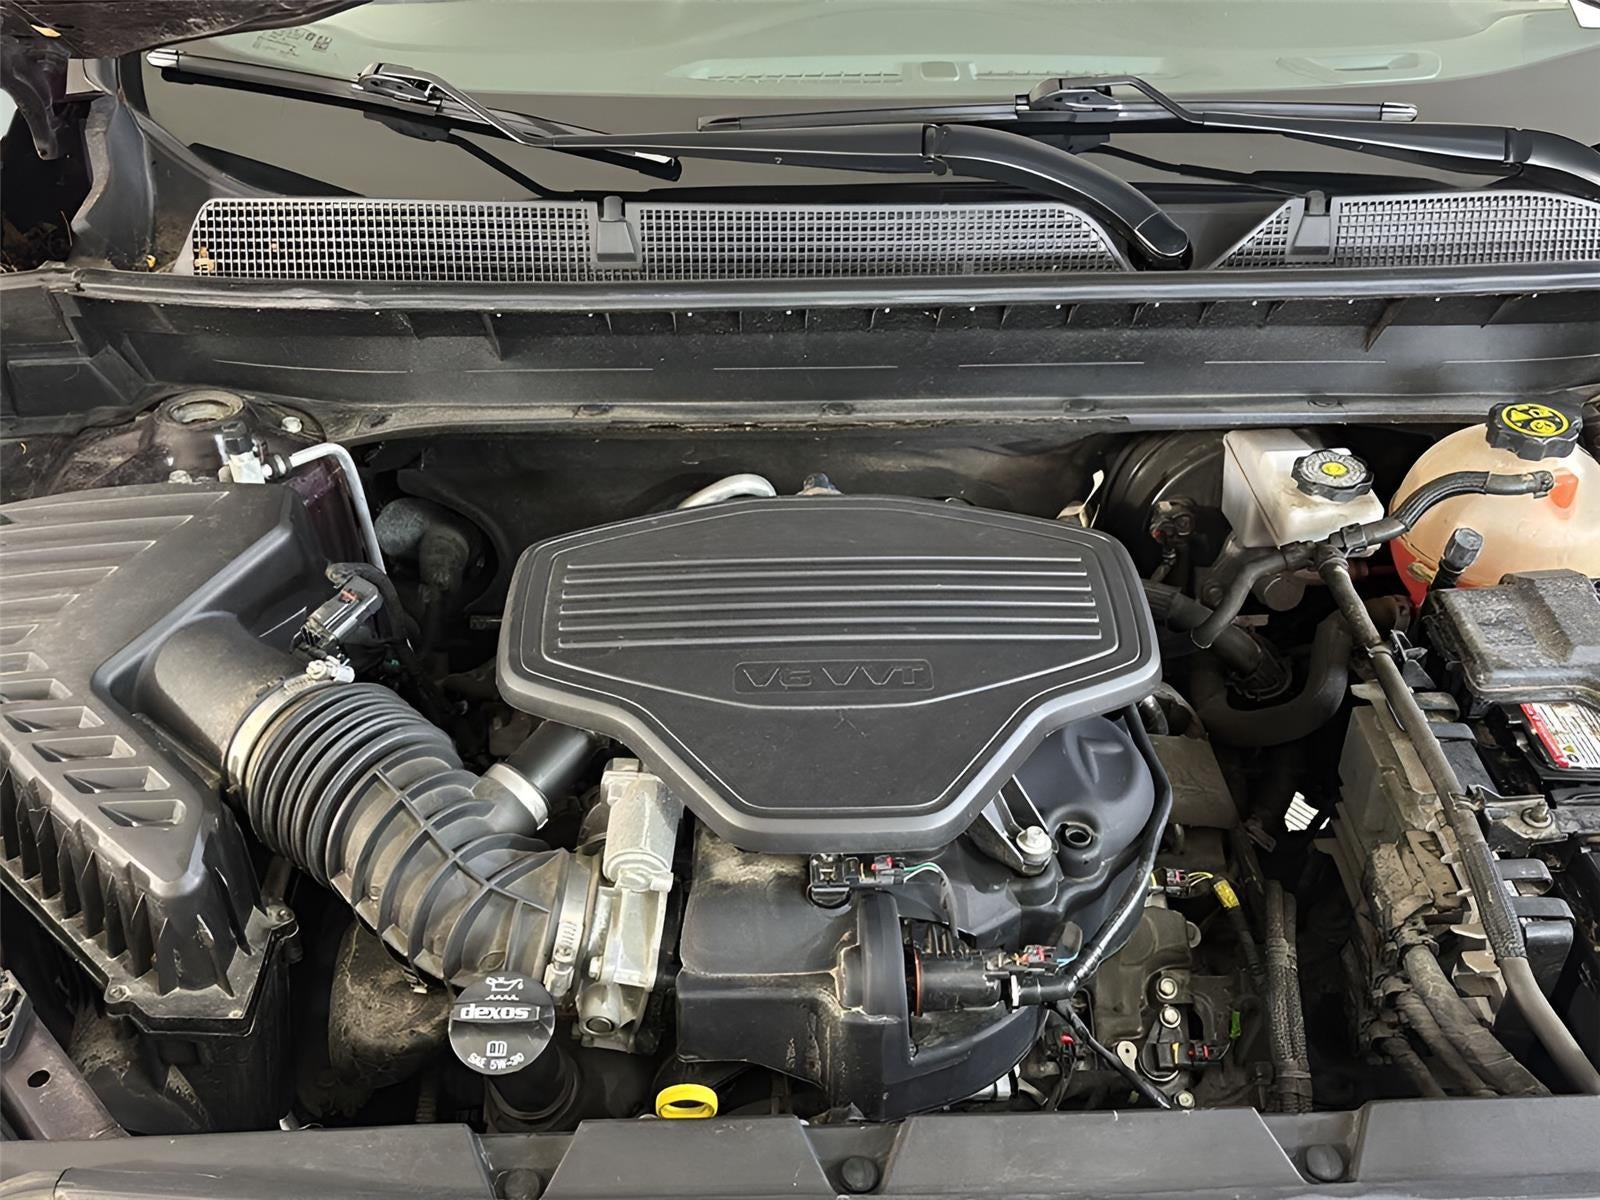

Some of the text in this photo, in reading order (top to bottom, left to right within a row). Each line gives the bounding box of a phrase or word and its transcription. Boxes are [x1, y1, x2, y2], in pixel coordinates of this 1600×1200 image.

[743, 665, 924, 688] V6 VVT
[460, 1003, 531, 1020] dexos
[467, 1052, 487, 1069] SAE
